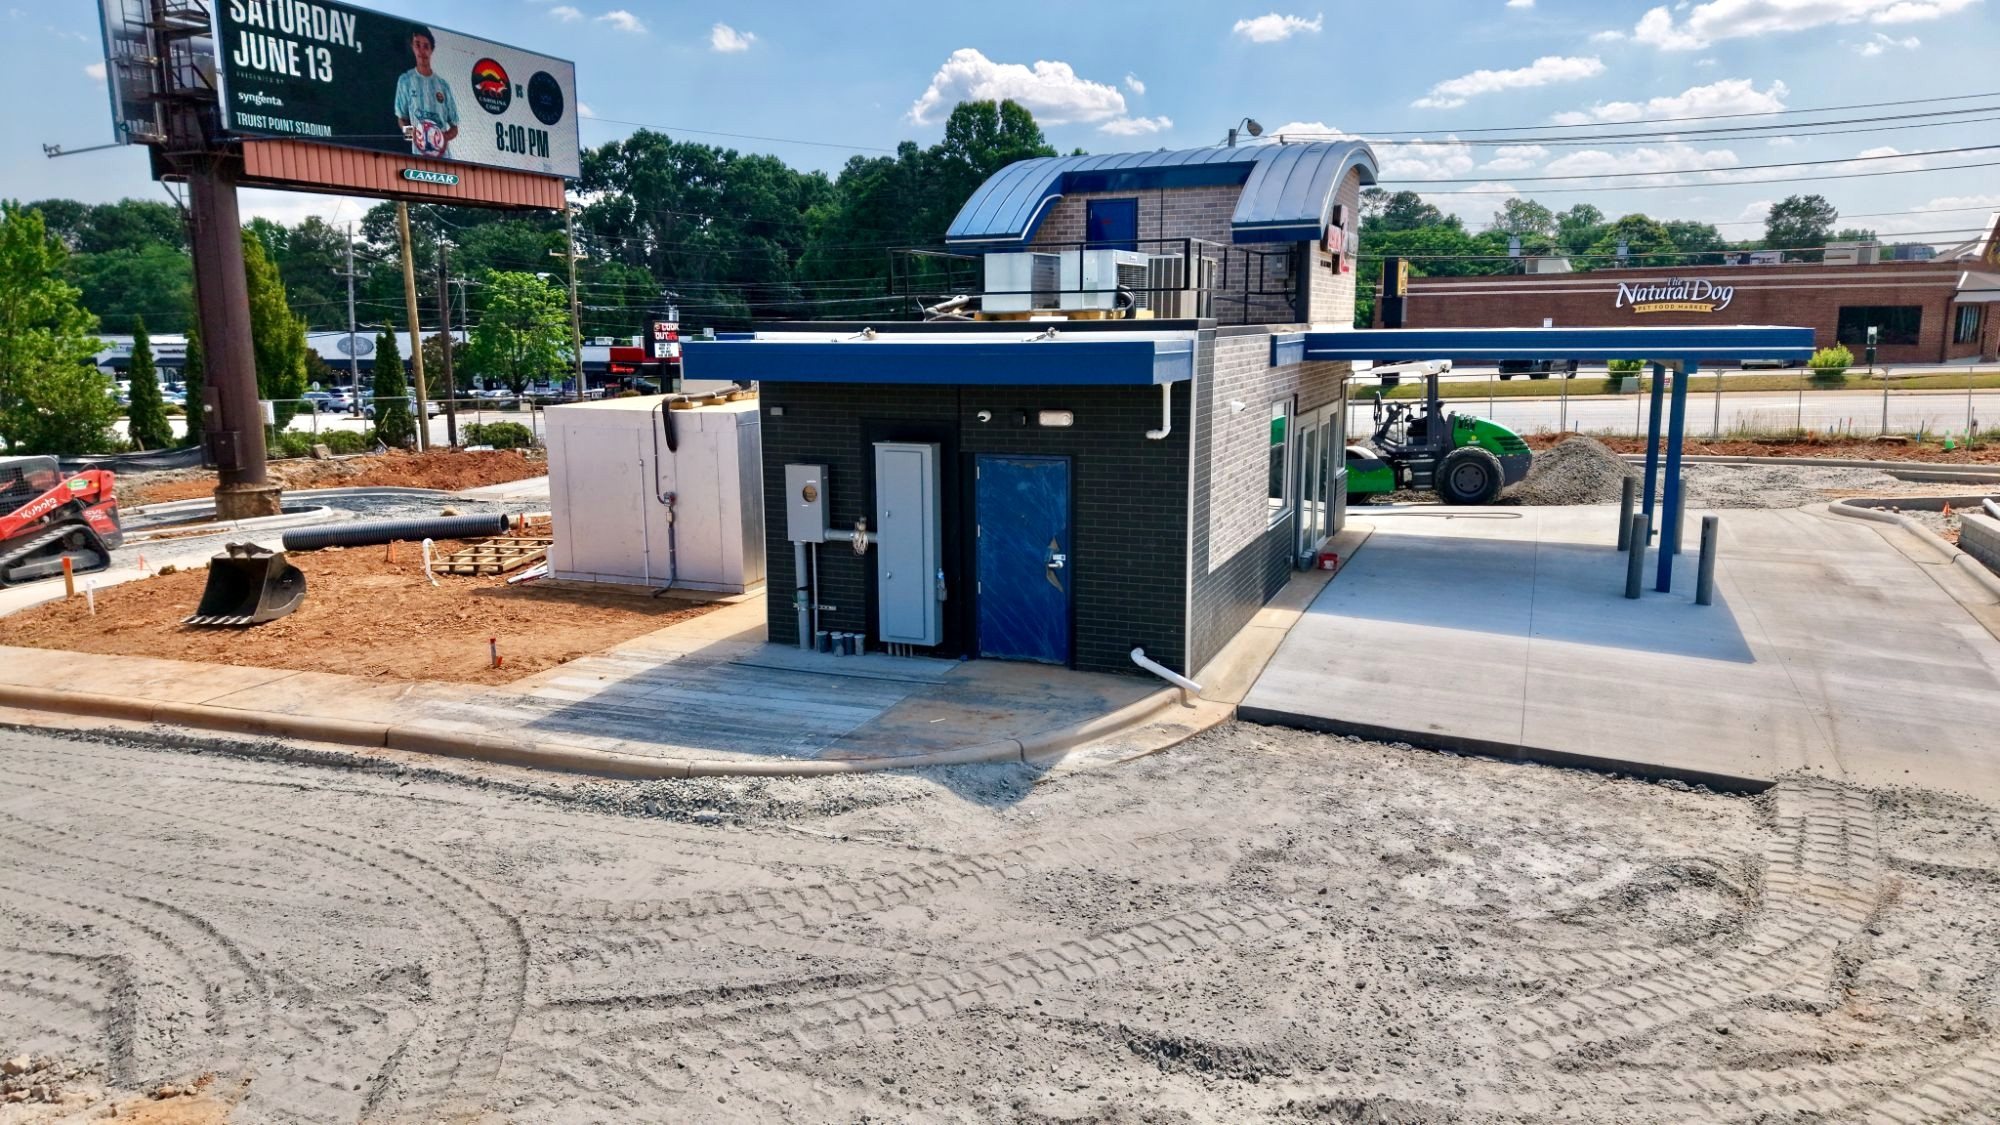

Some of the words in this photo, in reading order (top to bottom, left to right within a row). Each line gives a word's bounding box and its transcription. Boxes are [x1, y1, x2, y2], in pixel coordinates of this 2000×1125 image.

[230, 0, 362, 53] SATURDAY,
[233, 30, 301, 77] JUNE
[305, 45, 333, 83] 13
[236, 112, 267, 129] TRUIST
[268, 116, 294, 133] POINT
[295, 121, 332, 137] STADIUM
[495, 121, 526, 155] 8:00
[528, 127, 550, 159] PM
[409, 169, 454, 184] LAMAR
[1615, 282, 1691, 308] Natural
[1691, 279, 1735, 311] Dog
[1667, 277, 1683, 287] The
[20, 497, 58, 520] Kubota
